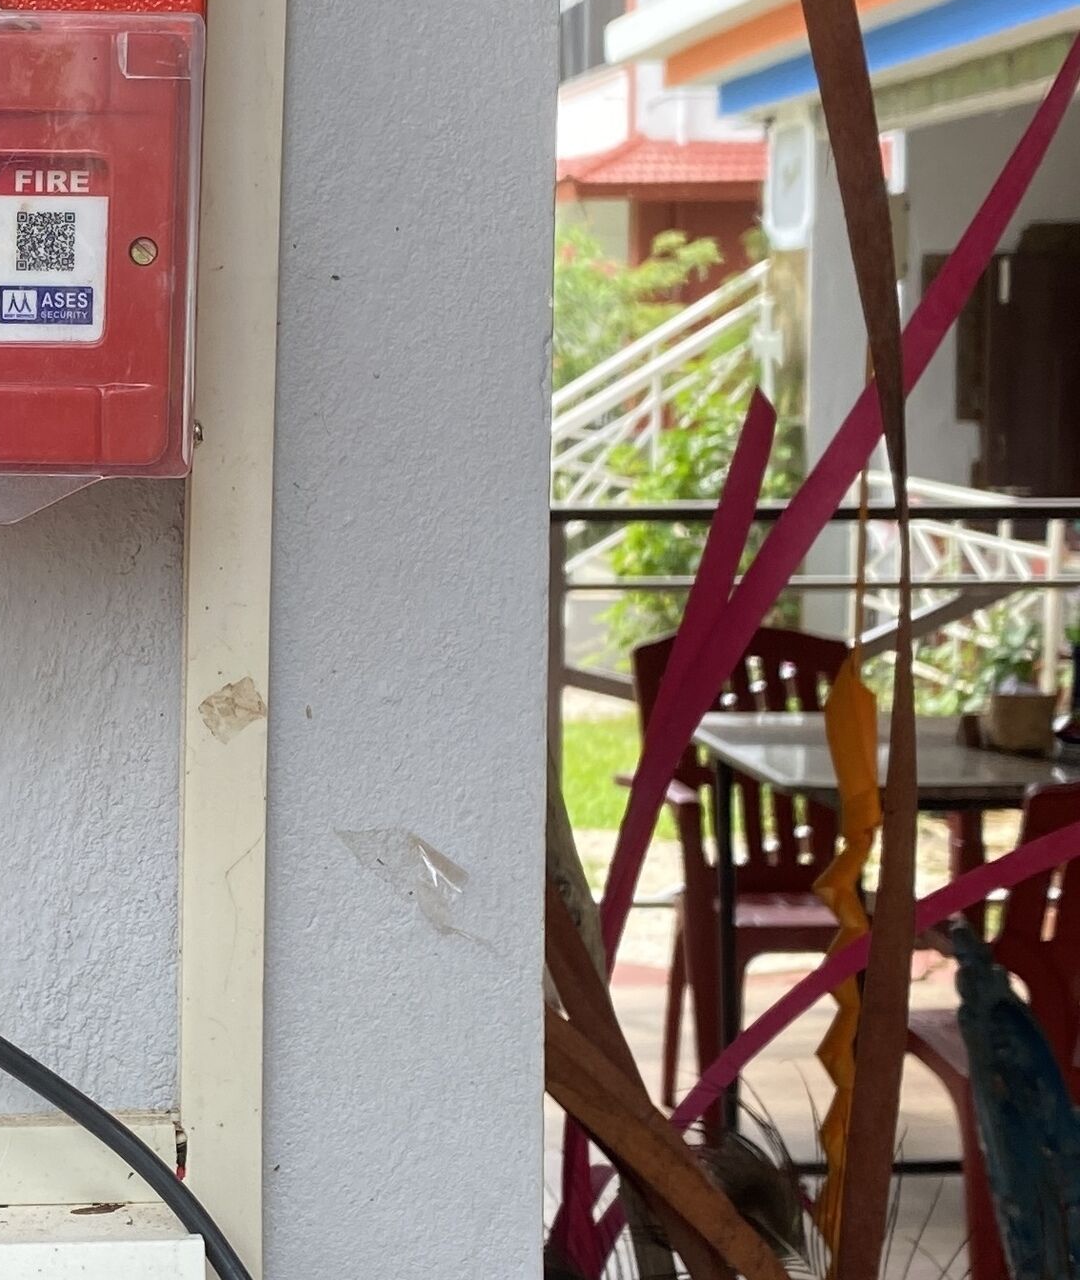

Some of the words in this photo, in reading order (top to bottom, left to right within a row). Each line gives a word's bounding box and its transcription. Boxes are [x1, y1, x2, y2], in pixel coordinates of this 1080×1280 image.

[15, 170, 90, 193] FIRE
[41, 291, 88, 309] ASES
[40, 310, 89, 320] SECURITY
